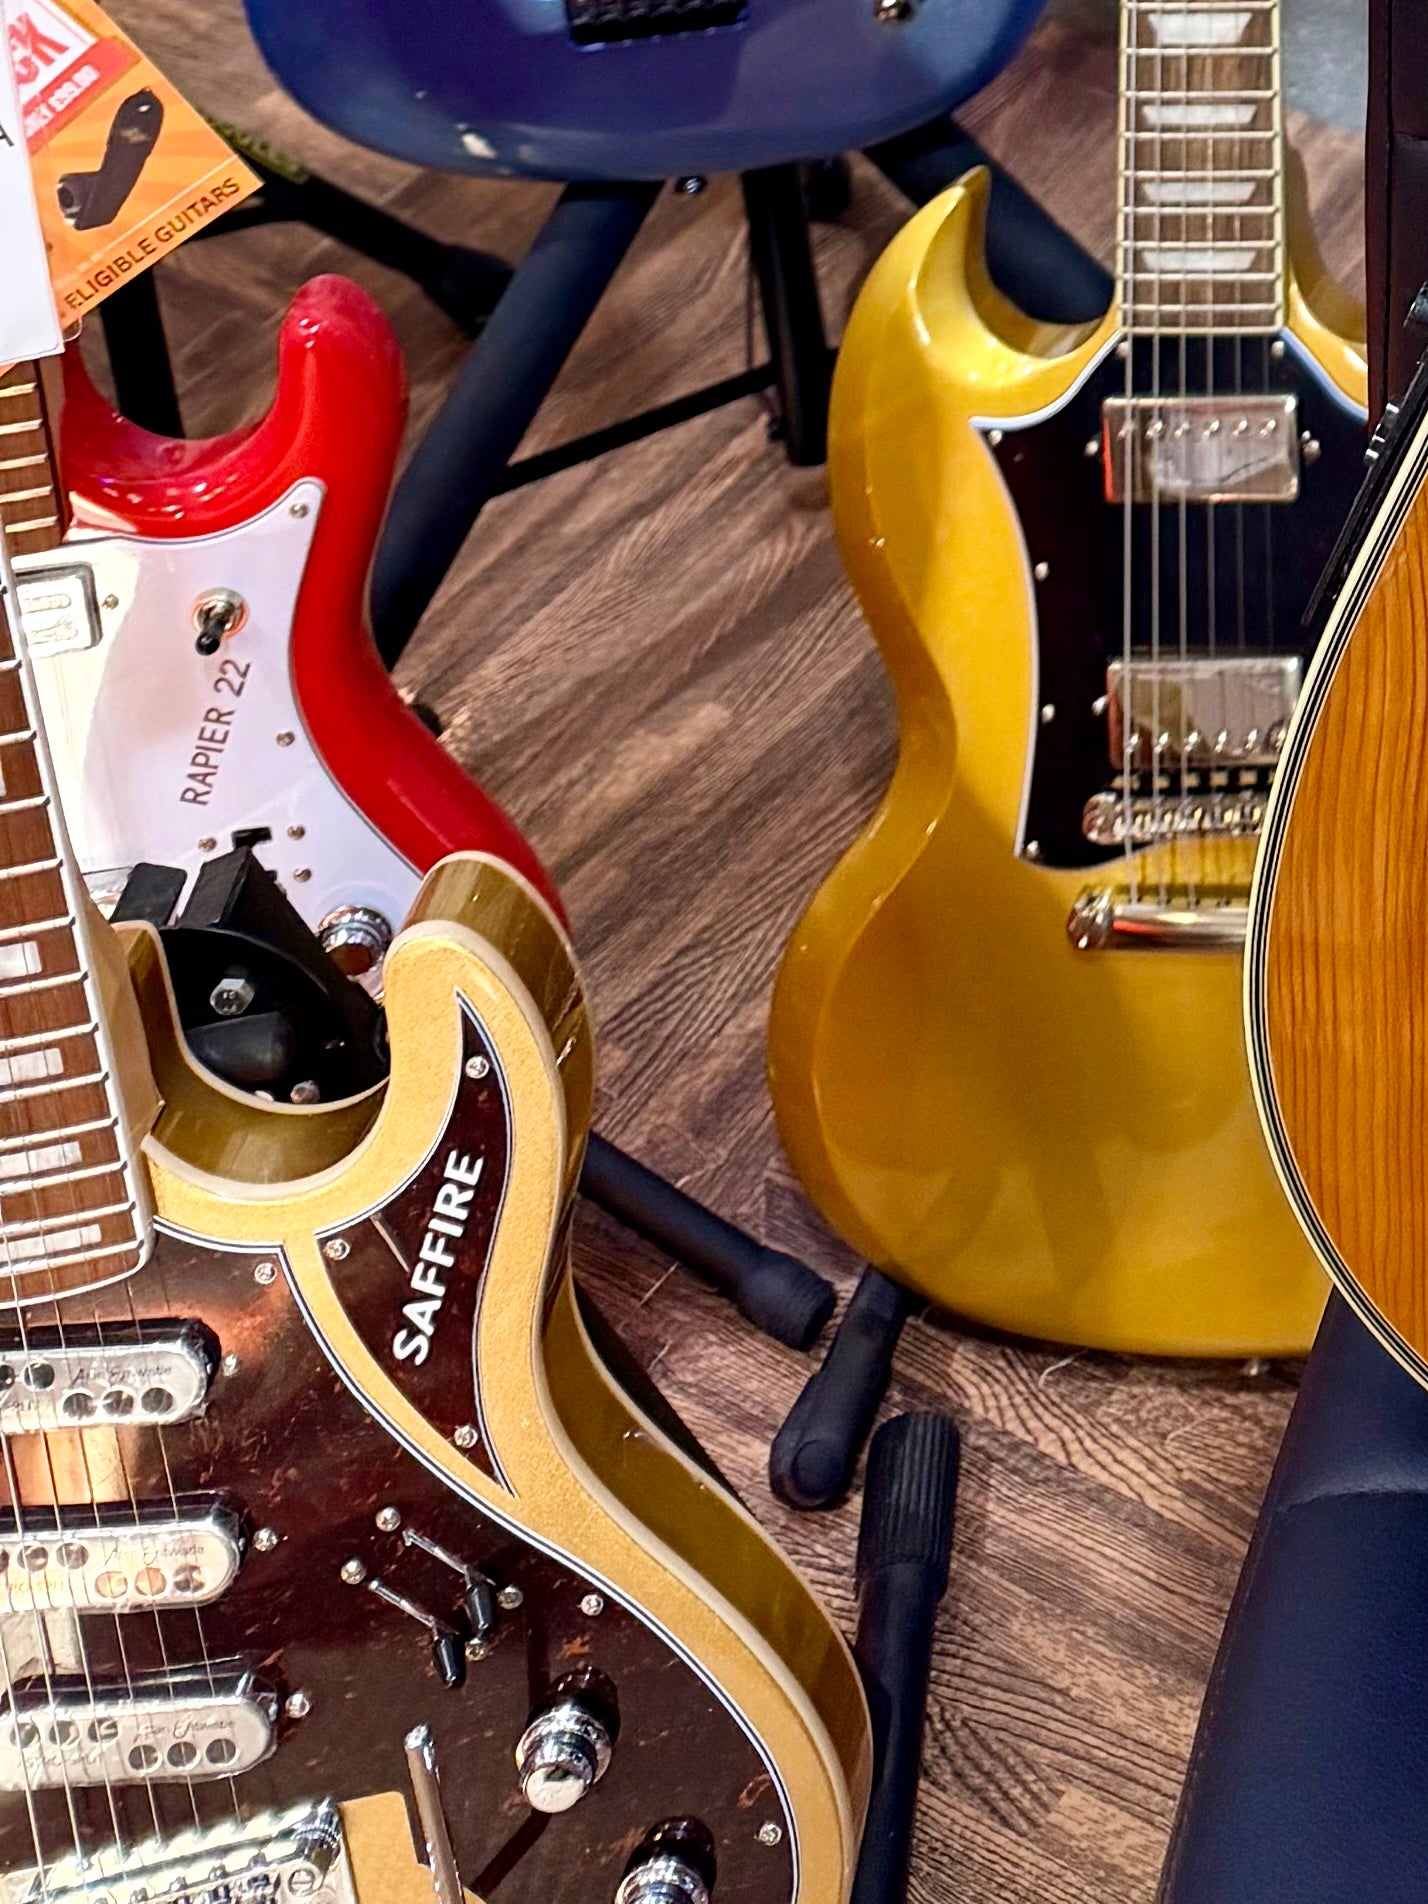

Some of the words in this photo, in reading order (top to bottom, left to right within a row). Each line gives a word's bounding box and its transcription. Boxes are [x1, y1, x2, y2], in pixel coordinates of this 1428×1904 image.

[63, 238, 155, 312] ELIGIBLE
[153, 176, 241, 245] GUITARS
[179, 704, 236, 806] RAPIER
[213, 658, 252, 698] 22
[392, 1149, 486, 1367] SAFFIRE
